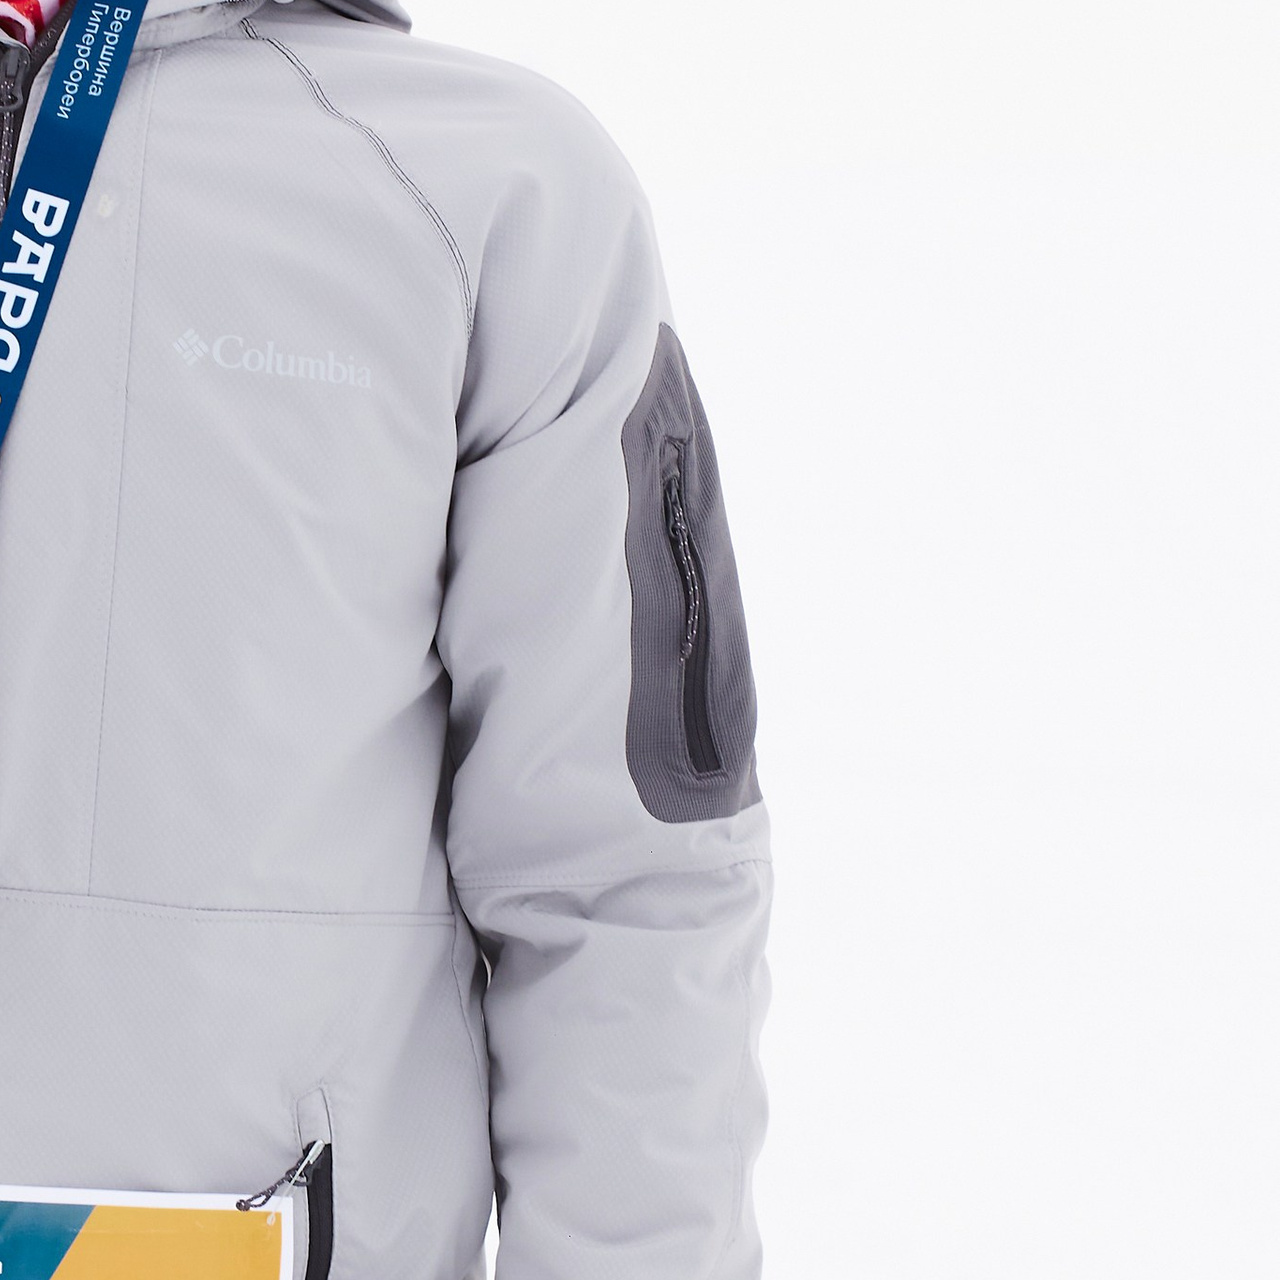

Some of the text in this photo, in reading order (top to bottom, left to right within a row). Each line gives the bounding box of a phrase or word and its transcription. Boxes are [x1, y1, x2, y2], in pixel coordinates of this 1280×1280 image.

[56, 2, 110, 120] Гипербореи
[88, 7, 132, 97] Вершина
[212, 334, 372, 389] Columbia
